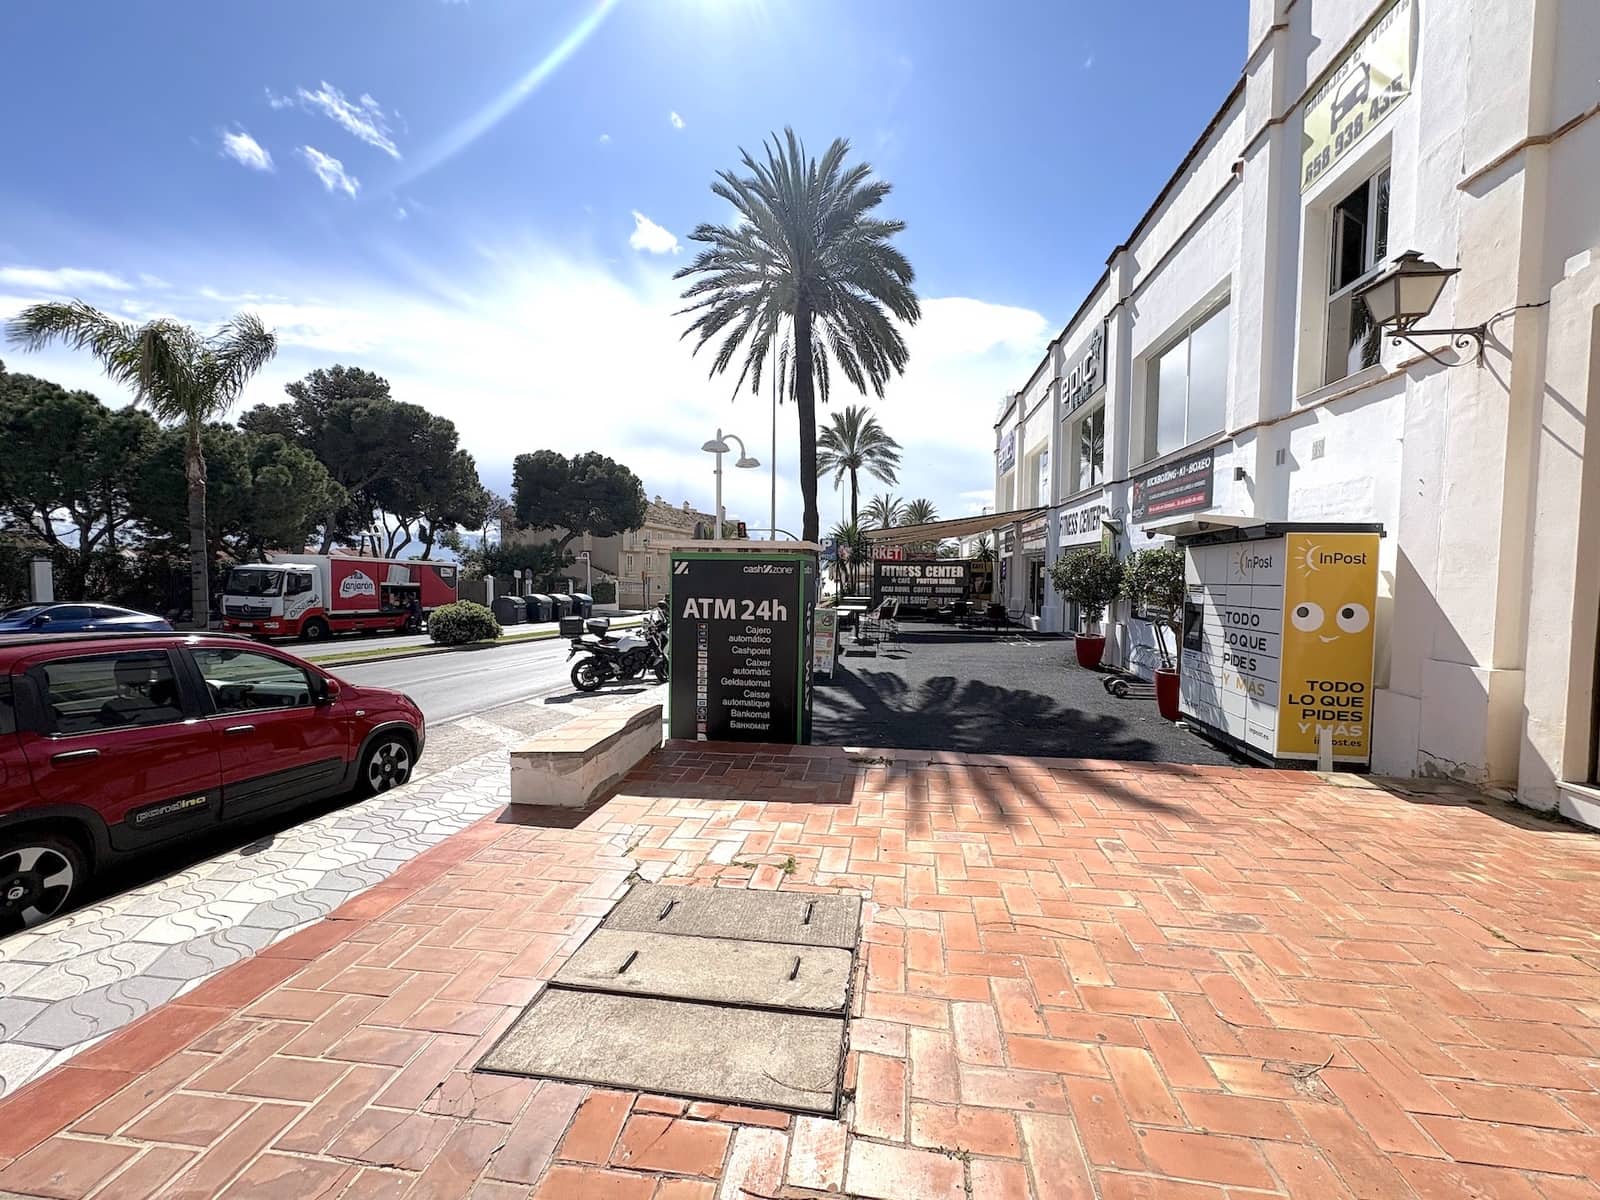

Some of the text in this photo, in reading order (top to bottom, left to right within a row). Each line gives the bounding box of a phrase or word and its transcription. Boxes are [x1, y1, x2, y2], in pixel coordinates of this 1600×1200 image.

[1305, 144, 1331, 184] 658
[1335, 112, 1364, 157] 938
[870, 546, 901, 560] RKET
[1319, 552, 1367, 565] InPost
[1246, 555, 1273, 569] InPost
[881, 565, 921, 577] FITNESS
[925, 565, 964, 578] CENTER
[682, 598, 788, 622] ATM 24h
[1225, 611, 1260, 627] TODO
[745, 625, 772, 636] Cajero
[728, 634, 772, 644] automático
[1224, 631, 1267, 652] LO QUE
[731, 646, 771, 656] Cashpoint
[745, 658, 772, 667] Caixer
[1223, 652, 1257, 671] PIDES
[720, 677, 771, 688] Geldautomat
[1223, 672, 1230, 686] Y
[1306, 680, 1365, 693] TODO
[743, 689, 771, 699] Caisse
[1288, 693, 1365, 708] LO QUE
[721, 698, 770, 708] automatique
[730, 709, 771, 719] Bankomat
[1302, 708, 1363, 722] PIDES
[729, 720, 771, 730] Банкомат
[1298, 722, 1312, 734] Y
[136, 796, 206, 823] pandina
